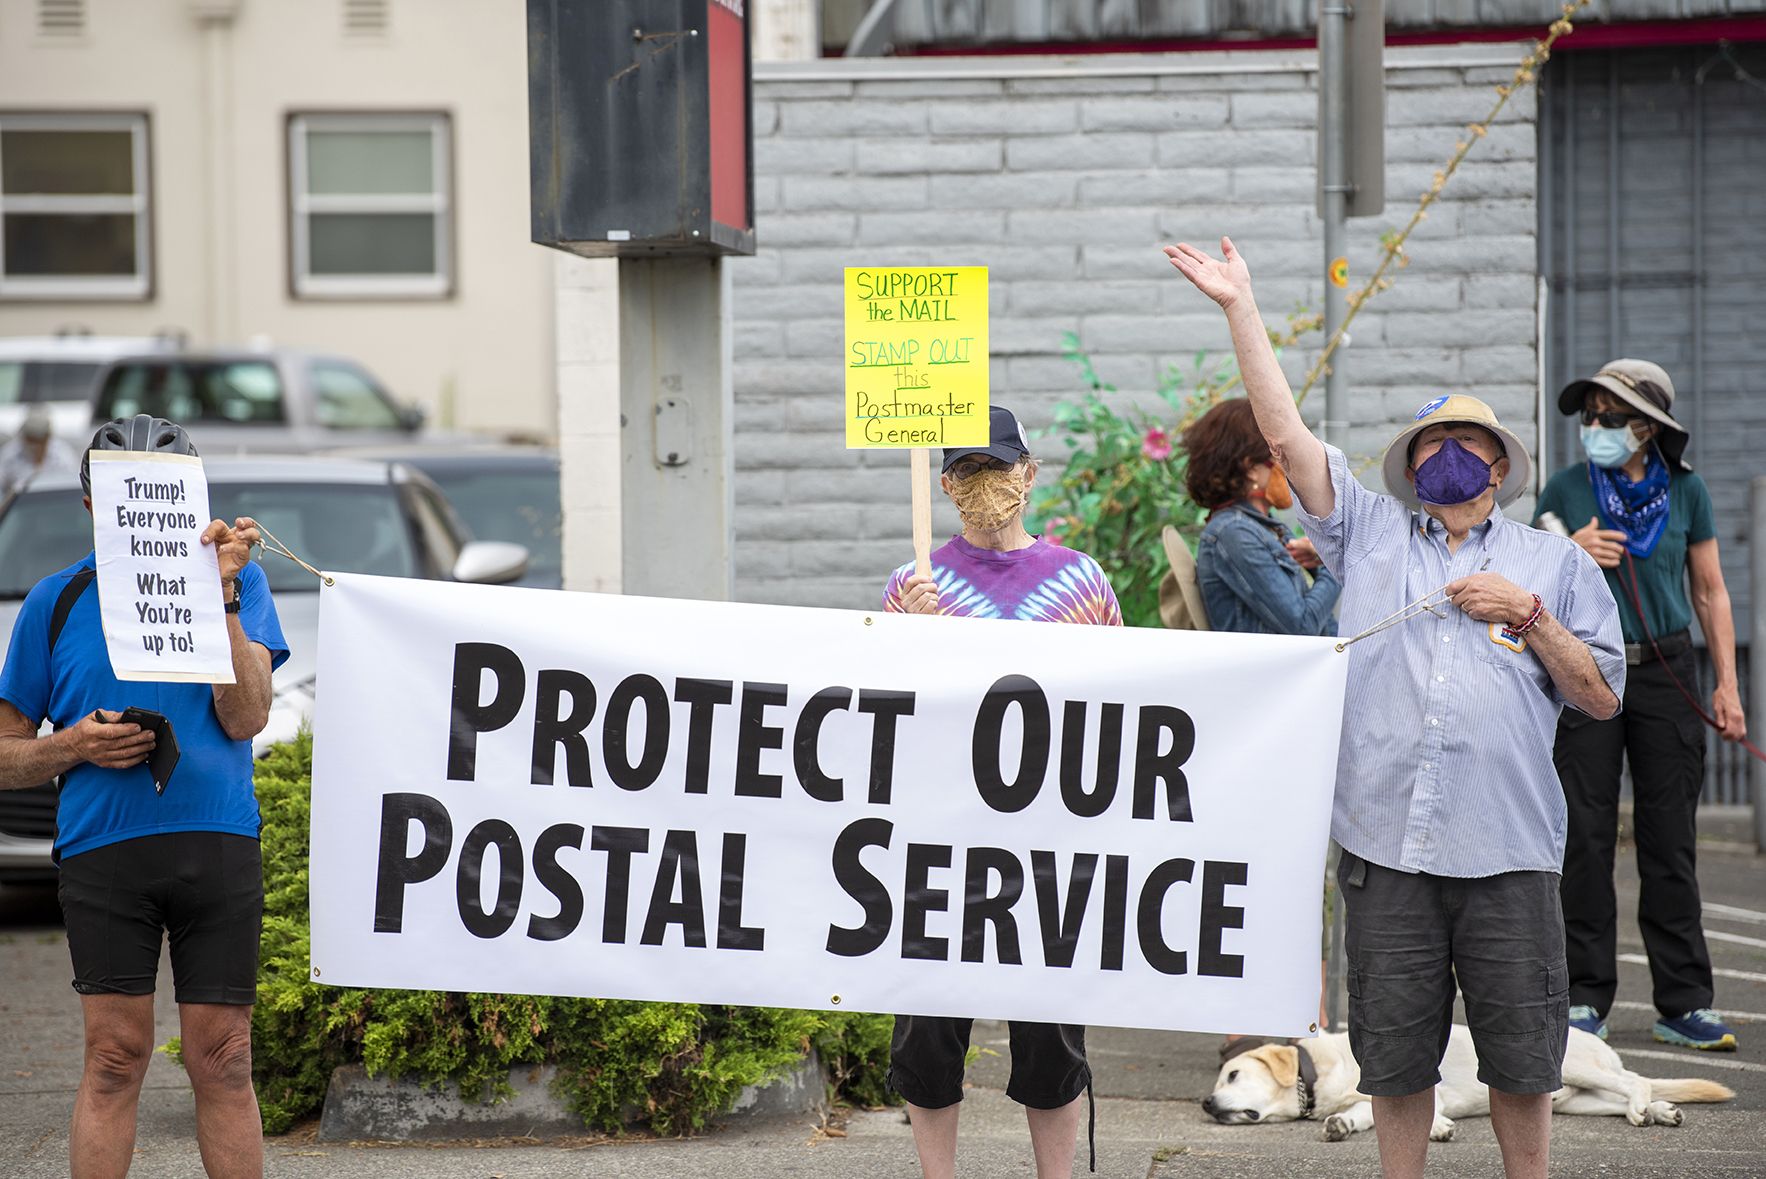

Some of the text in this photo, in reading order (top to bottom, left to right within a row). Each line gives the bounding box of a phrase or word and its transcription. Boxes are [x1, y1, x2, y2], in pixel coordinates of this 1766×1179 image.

[857, 272, 958, 299] SUPPORT
[867, 299, 956, 321] the MAIL
[852, 338, 975, 366] STAMP OUT
[894, 367, 929, 387] this
[856, 390, 975, 418] Postmaster
[865, 417, 944, 443] General
[124, 477, 185, 505] Trump!
[117, 506, 197, 532] Everyone
[130, 535, 188, 558] knows
[136, 573, 186, 596] What
[135, 602, 192, 624] You're
[142, 632, 194, 656] up to!
[446, 643, 1196, 822] PROTECT OUR
[374, 793, 1249, 979] POSTAL SERVICE
